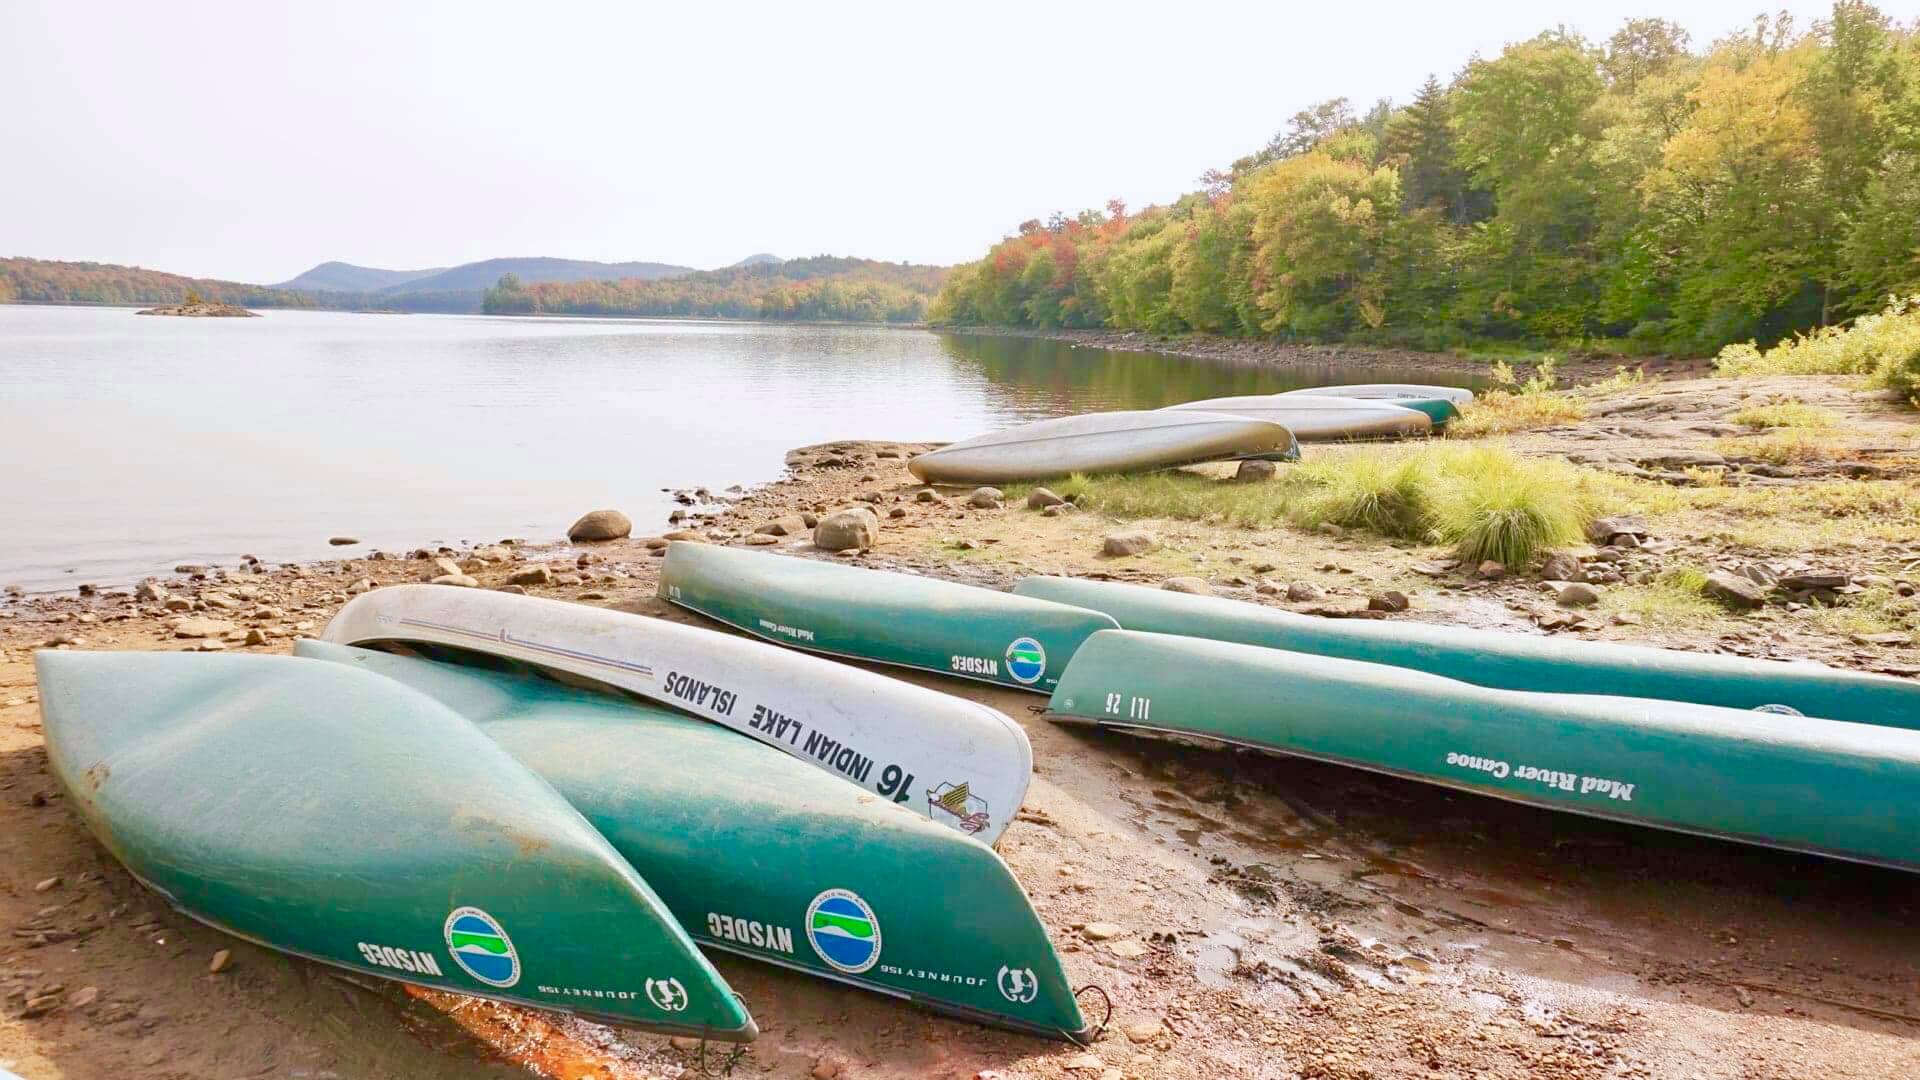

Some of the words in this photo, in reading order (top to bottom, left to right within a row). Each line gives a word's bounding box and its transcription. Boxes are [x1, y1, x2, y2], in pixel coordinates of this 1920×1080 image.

[951, 655, 998, 676] NYSDEC
[663, 671, 738, 716] ISLANDS
[1105, 692, 1121, 714] 26
[748, 703, 802, 745] LAKE
[802, 729, 874, 783] INDIAN
[1446, 751, 1510, 778] Canoe
[876, 763, 916, 804] 16
[1514, 764, 1577, 792] River
[1581, 776, 1636, 802] Mad
[707, 912, 794, 954] NYSDEC
[357, 941, 443, 977] NYSDEC
